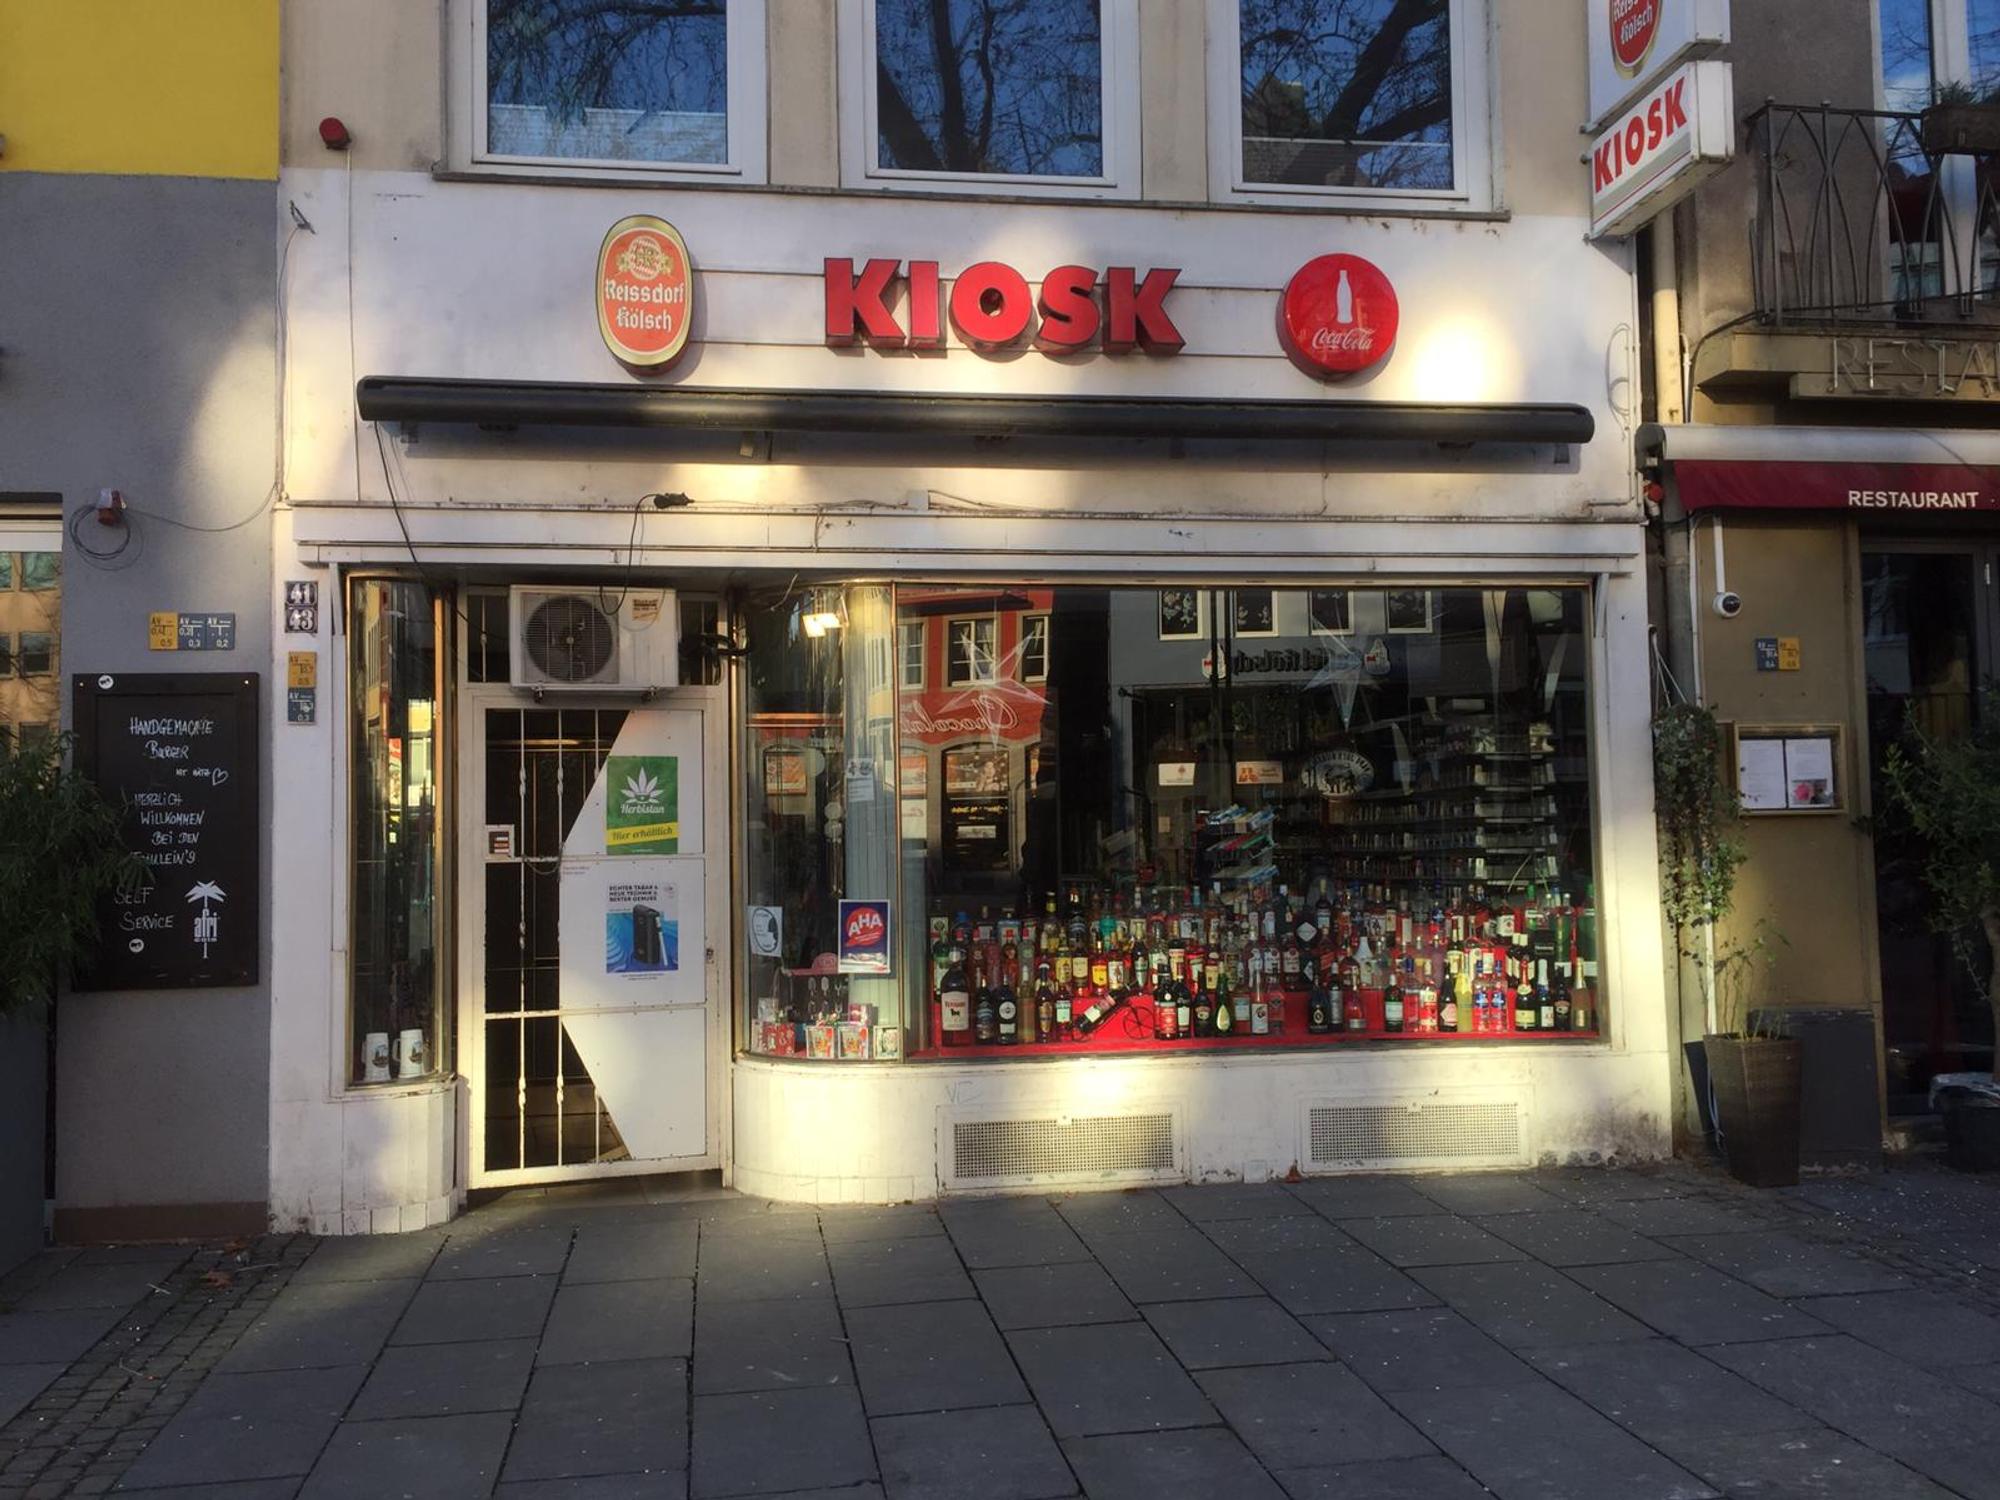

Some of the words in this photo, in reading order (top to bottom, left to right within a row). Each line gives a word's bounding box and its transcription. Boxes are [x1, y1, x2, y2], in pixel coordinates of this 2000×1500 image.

[1594, 76, 1688, 193] KIOSK
[605, 279, 685, 304] Reissdorf
[824, 257, 1185, 352] KIOSK
[616, 306, 672, 332] Kölsch
[1831, 338, 2000, 396] RESTA
[1848, 489, 1979, 508] RESTAURANT
[290, 582, 312, 604] 41
[289, 608, 313, 630] 43
[620, 803, 665, 814] Herbistan
[194, 908, 218, 938] afri
[848, 912, 884, 937] AHA
